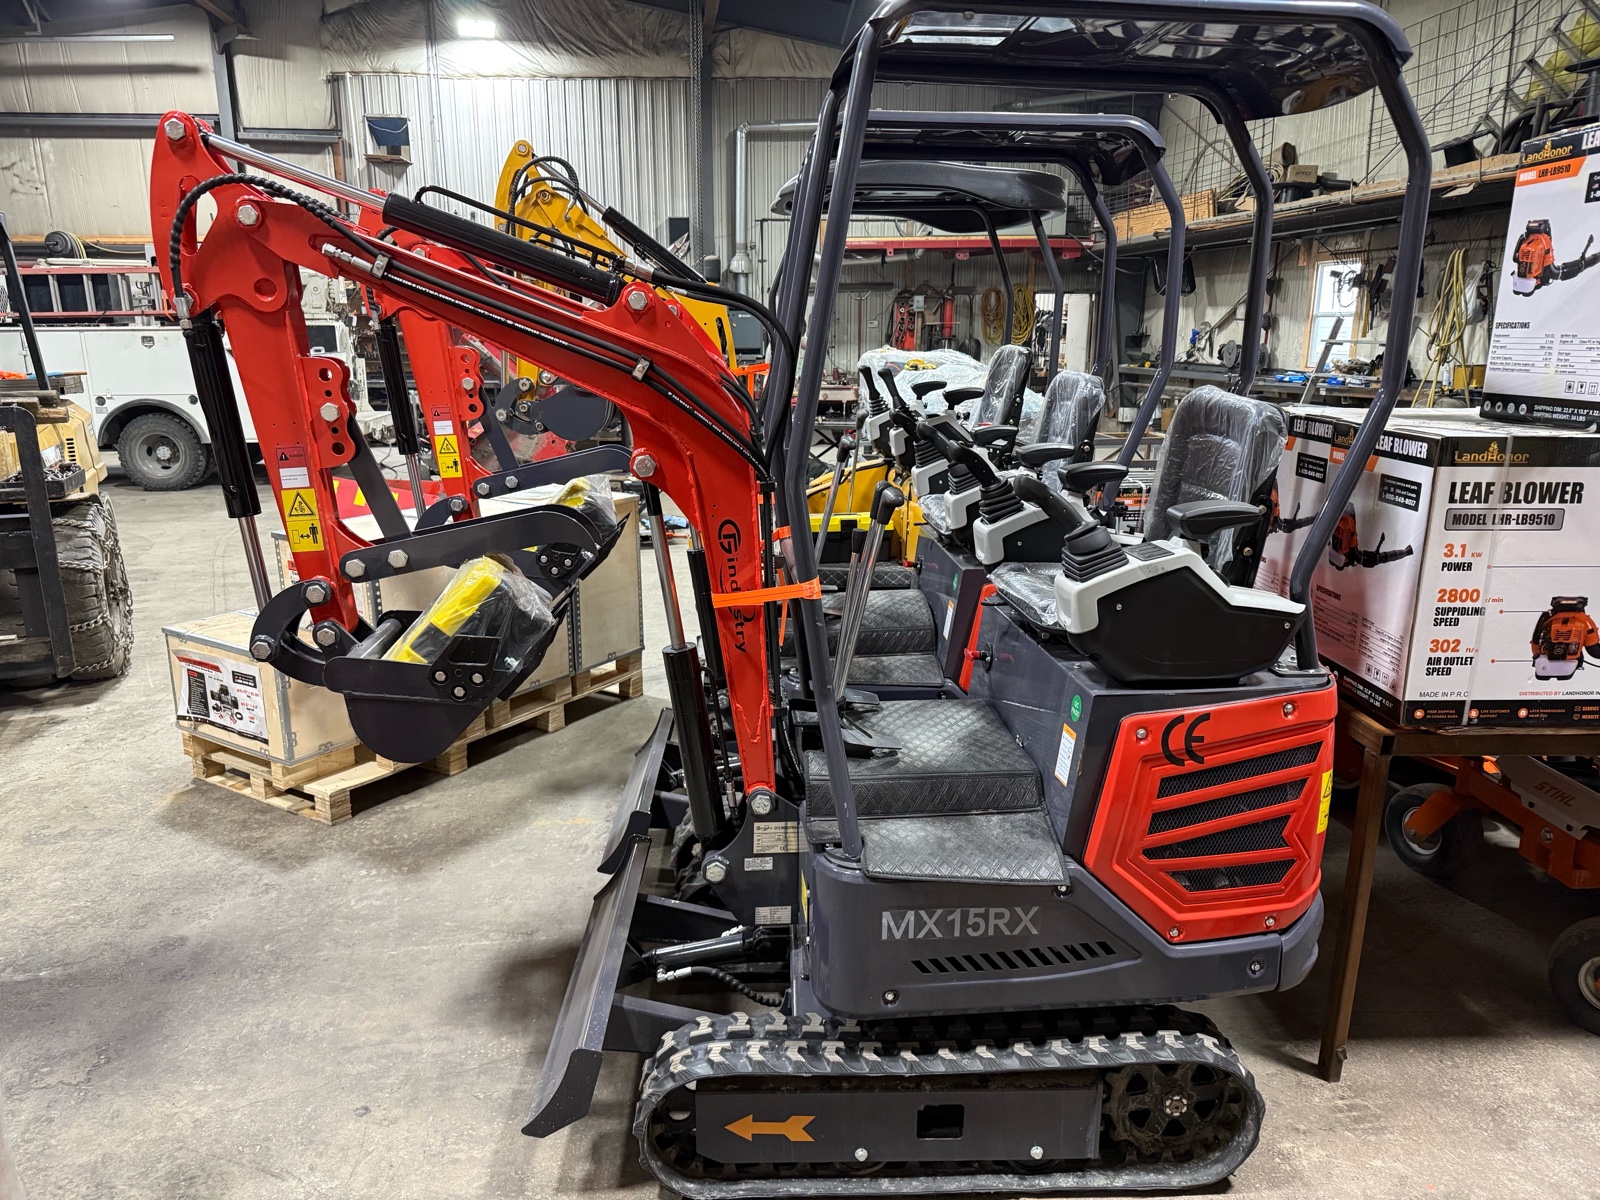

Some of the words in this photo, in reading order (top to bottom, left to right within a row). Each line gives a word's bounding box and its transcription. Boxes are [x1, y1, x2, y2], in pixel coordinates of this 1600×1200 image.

[1522, 144, 1573, 163] LandHonor
[1519, 170, 1537, 182] MODEL
[1538, 163, 1572, 178] LHR-LB9510
[1495, 321, 1530, 330] SPECIFICATIONS
[1534, 404, 1553, 412] SHIPPING
[1293, 418, 1308, 434] LEAF
[1307, 420, 1333, 438] BLOWER
[1393, 437, 1428, 459] BLOWER
[1454, 445, 1530, 463] LandHonor
[1448, 481, 1496, 504] LEAF
[1499, 481, 1585, 505] BLOWER
[1451, 513, 1487, 526] MODEL
[1491, 513, 1556, 526] LHR-LB9510
[1443, 543, 1467, 558] 3.1
[1441, 562, 1473, 572] POWER
[1437, 588, 1481, 603] 2800
[1434, 606, 1486, 616] SUPPIDLING
[1433, 617, 1460, 627] SPEED
[1429, 638, 1461, 653] 302
[1426, 656, 1443, 666] AIR
[1443, 656, 1474, 666] OUTLET
[1425, 667, 1452, 677] SPEED
[1161, 713, 1211, 767] CE
[1534, 781, 1576, 807] STIHL
[881, 906, 1039, 941] MX15RX
